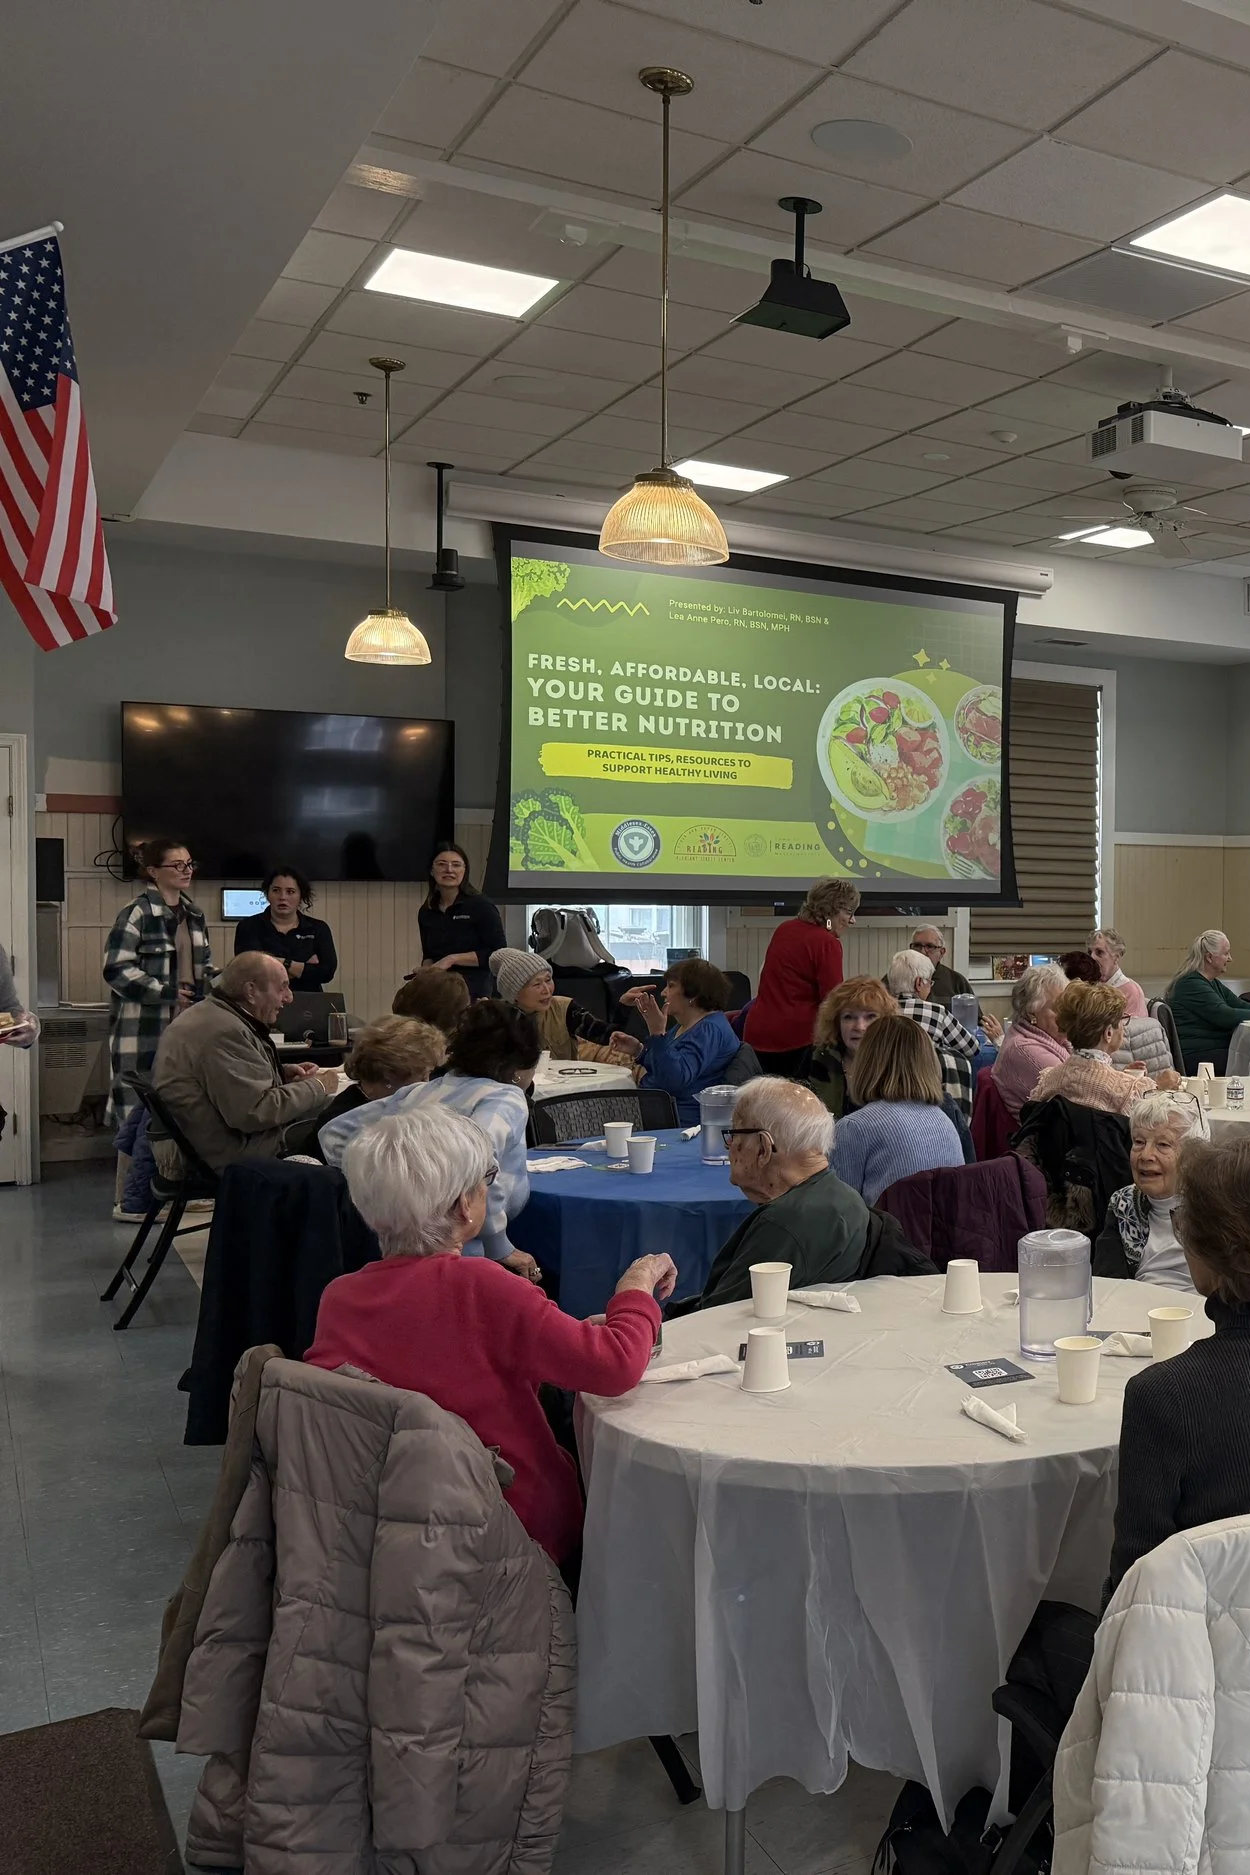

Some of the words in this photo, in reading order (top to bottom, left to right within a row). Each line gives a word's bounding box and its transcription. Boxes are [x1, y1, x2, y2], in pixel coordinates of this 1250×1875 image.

[669, 599, 711, 612] Presented
[713, 604, 726, 614] by:
[728, 606, 740, 614] Liv
[742, 608, 788, 621] Bartolomei,
[789, 613, 803, 623] RN,
[805, 615, 822, 624] BSN
[823, 617, 830, 625] &
[669, 611, 684, 621] Lea
[686, 613, 709, 624] Anne
[710, 616, 731, 627] Pero,
[733, 618, 748, 629] RN,
[749, 620, 769, 631] BSN,
[771, 623, 790, 633] MPH
[528, 653, 603, 676] FRESH,
[610, 661, 747, 689] AFFORDABLE,
[753, 674, 821, 694] LOCAL:
[526, 677, 605, 702] YOUR
[614, 685, 699, 710] GUIDE
[707, 692, 740, 713] TO
[528, 706, 628, 732] BETTER
[638, 714, 783, 744] NUTRITION
[587, 749, 646, 762] PRACTICAL
[648, 753, 674, 764] TIPS,
[676, 755, 736, 767] RESOURCES
[737, 759, 751, 768] TO
[602, 763, 653, 775] SUPPORT
[654, 766, 702, 778] HEALTHY
[703, 769, 737, 780] LIVING
[687, 844, 723, 855] READING
[774, 842, 821, 851] READING
